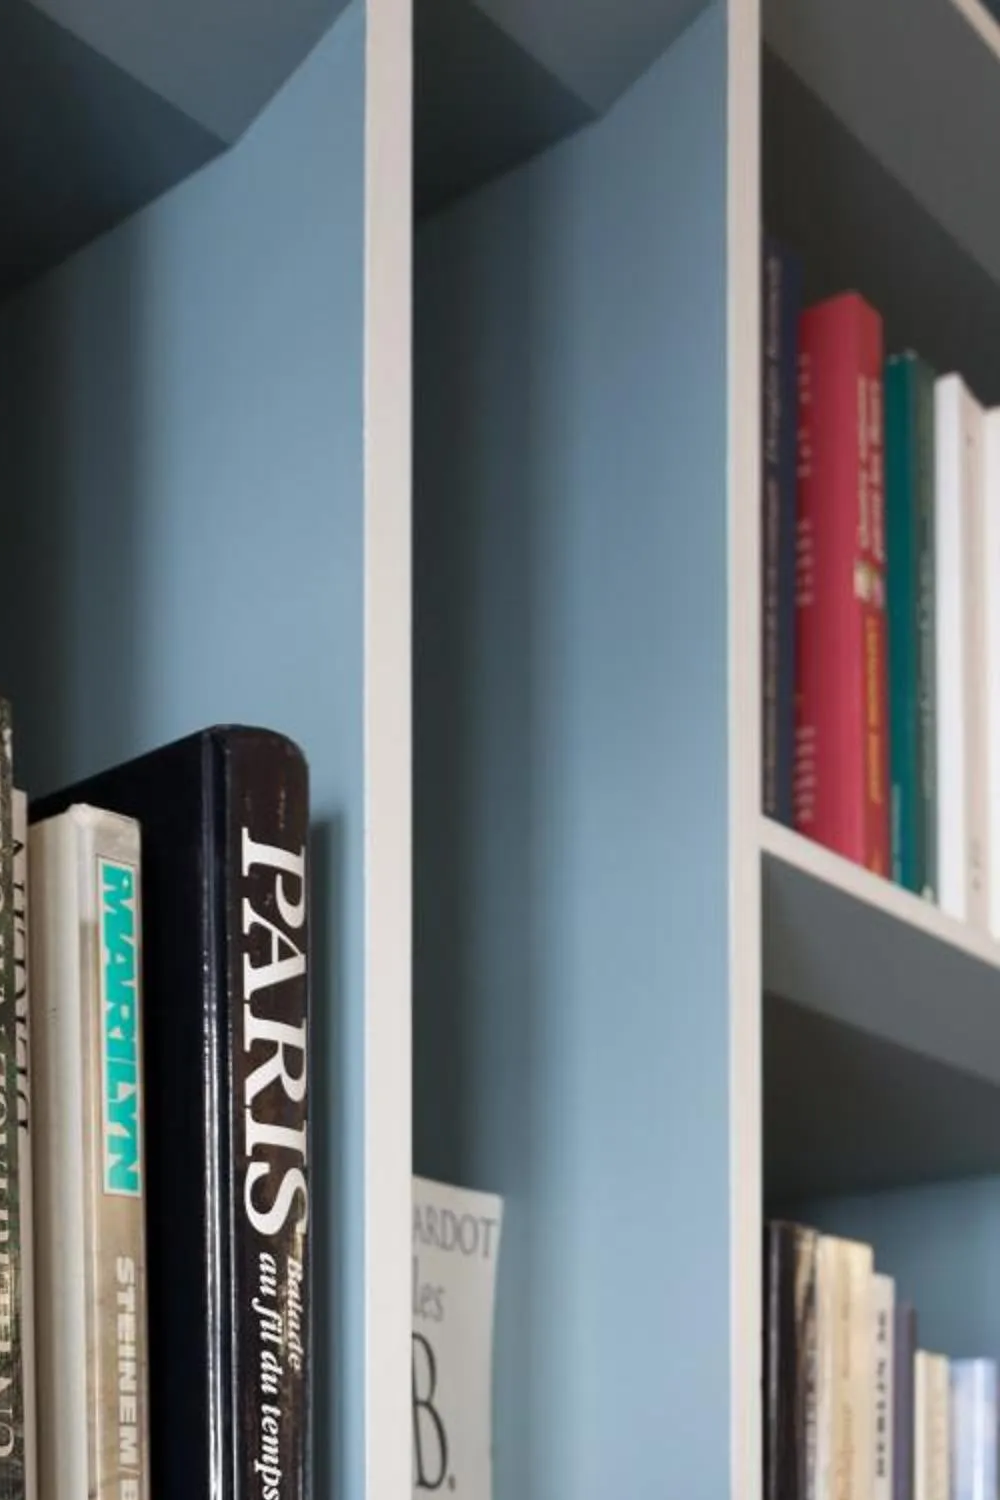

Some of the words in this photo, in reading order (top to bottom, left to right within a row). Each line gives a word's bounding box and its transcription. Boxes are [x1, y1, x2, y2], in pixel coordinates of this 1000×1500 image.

[102, 862, 140, 1192] MARILYN
[241, 826, 307, 1236] PARIS
[258, 1251, 278, 1298] au
[287, 1255, 304, 1373] Balade
[252, 1297, 284, 1346] fil
[260, 1350, 284, 1395] du
